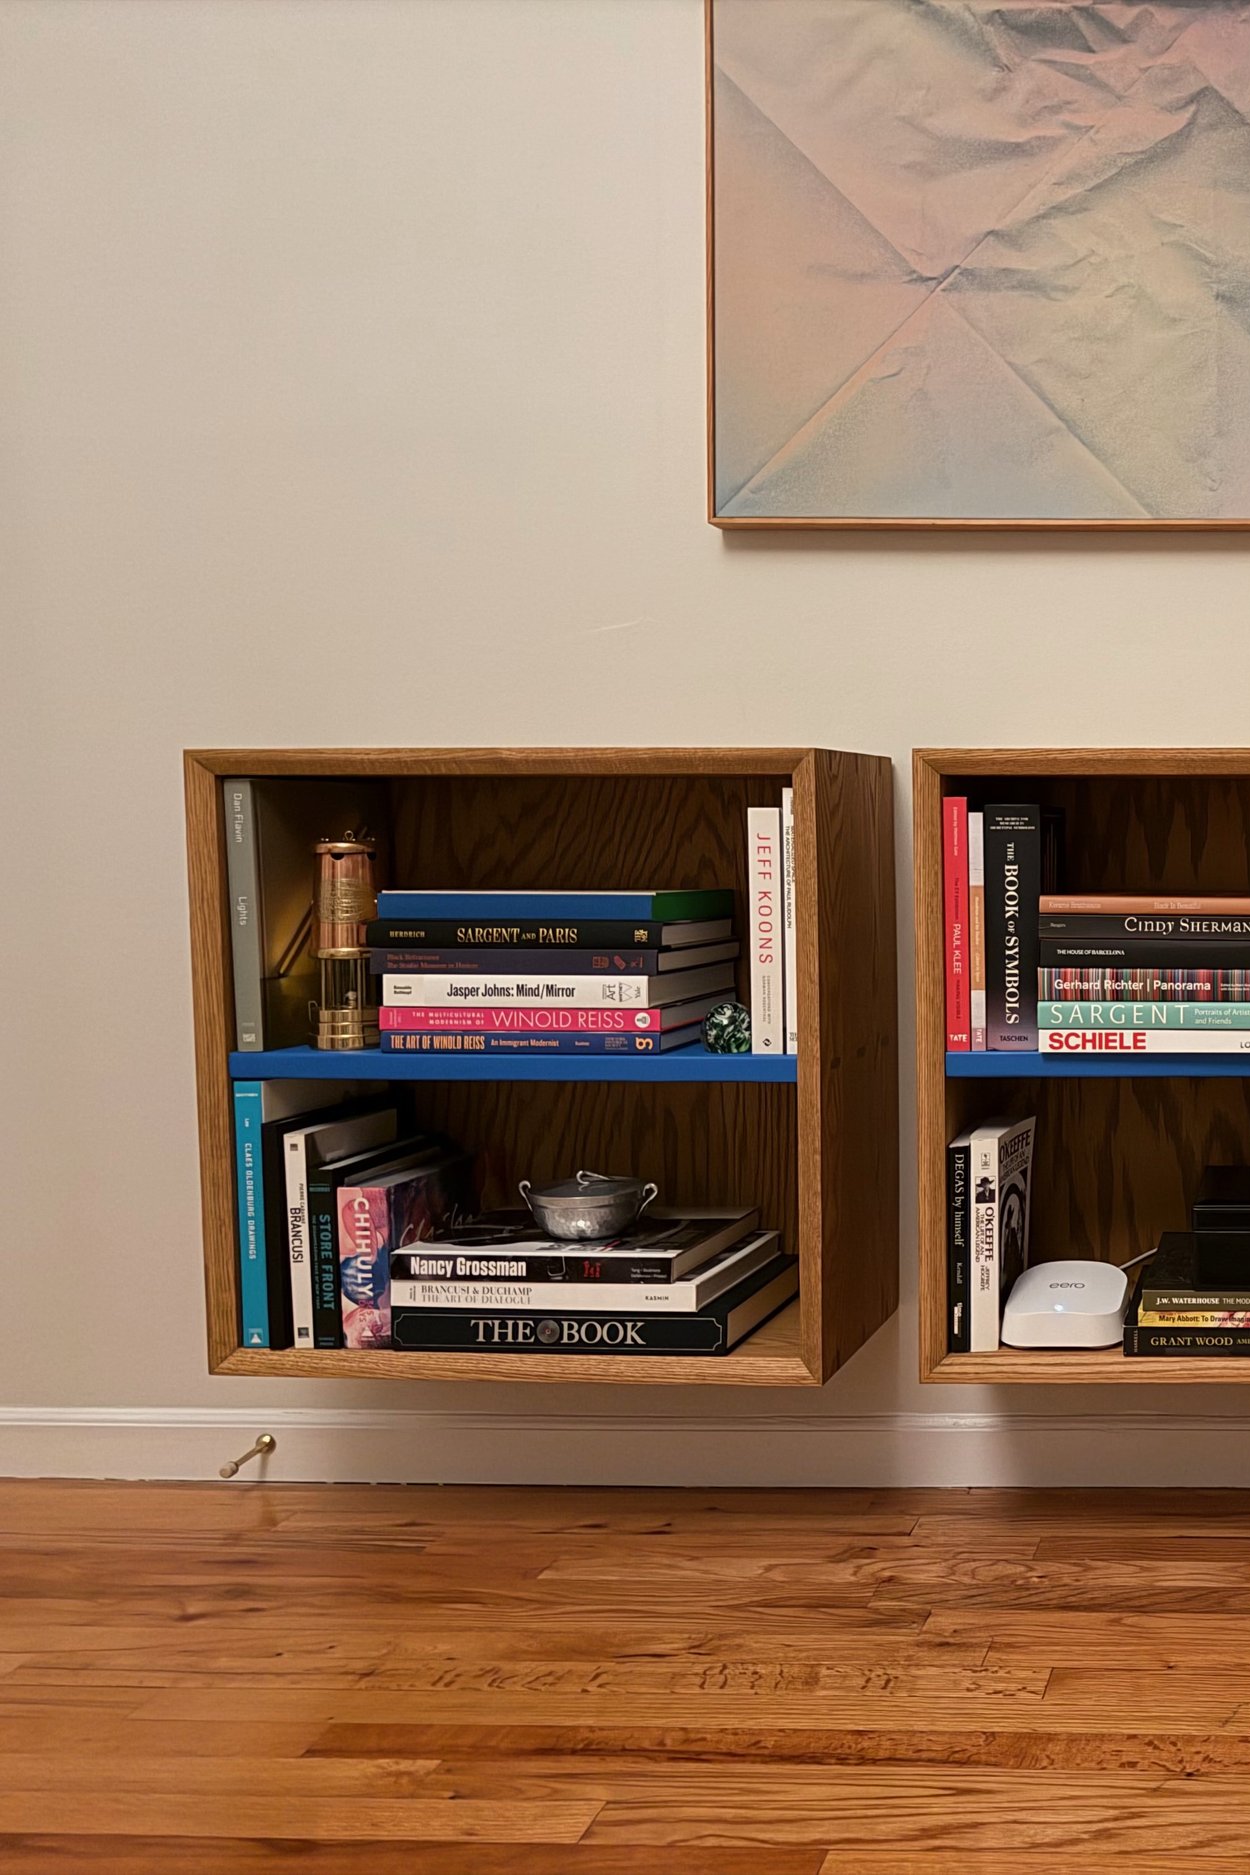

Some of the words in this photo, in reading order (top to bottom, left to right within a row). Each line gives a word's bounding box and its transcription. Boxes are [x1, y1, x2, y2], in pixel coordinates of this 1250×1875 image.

[233, 793, 243, 812] Dan
[234, 814, 244, 843] Flavin
[757, 832, 772, 880] JEFF
[1006, 842, 1015, 861] THE
[1004, 864, 1019, 918] BOOK
[236, 896, 248, 926] Lights
[457, 927, 520, 944] SARGENT
[521, 932, 537, 940] AND
[538, 927, 578, 943] PARIS
[758, 891, 774, 964] KOONS
[953, 923, 961, 949] PAUL
[1007, 920, 1015, 933] OF
[953, 950, 962, 974] KLEE
[446, 983, 480, 999] Jasper
[481, 983, 514, 997] Johns:
[516, 983, 576, 999] Mind/Mirror
[1005, 936, 1020, 1025] SYMBOLS
[1054, 979, 1101, 990] Gerhard
[1104, 979, 1144, 990] Richter
[1153, 980, 1211, 991] Panorama
[492, 1011, 571, 1029] WINOLD
[578, 1011, 625, 1029] REISS
[1050, 1004, 1190, 1025] SARGENT
[1194, 1008, 1222, 1016] Portraits
[1223, 1008, 1231, 1016] of
[390, 1035, 404, 1049] THE
[405, 1035, 420, 1049] ART
[421, 1035, 431, 1049] OF
[433, 1035, 462, 1049] WINOLD
[463, 1035, 485, 1050] REISS
[949, 1034, 968, 1042] TATE
[975, 1028, 983, 1043] TATE
[1048, 1032, 1147, 1050] SCHIELE
[245, 1143, 253, 1167] CLAES
[954, 1153, 965, 1194] DEGAS
[245, 1170, 255, 1217] OLDENBURG
[952, 1196, 965, 1208] by
[248, 1220, 256, 1260] DRAWINGS
[290, 1207, 304, 1263] BRANCUSI
[319, 1214, 333, 1259] STORE
[954, 1211, 965, 1247] himself
[984, 1206, 995, 1262] O'KEEFFE
[353, 1197, 374, 1297] CHIHULY
[980, 1245, 984, 1255] AN
[410, 1256, 454, 1278] Nancy
[456, 1257, 527, 1277] Grossman
[321, 1265, 335, 1310] FRONT
[421, 1285, 470, 1295] BRANCUSI
[472, 1287, 479, 1295] &
[482, 1286, 533, 1296] DUCHAMP
[470, 1320, 536, 1342] THE
[560, 1321, 647, 1345] BOOK
[1150, 1336, 1193, 1346] GRANT
[1195, 1337, 1234, 1346] WOOD
